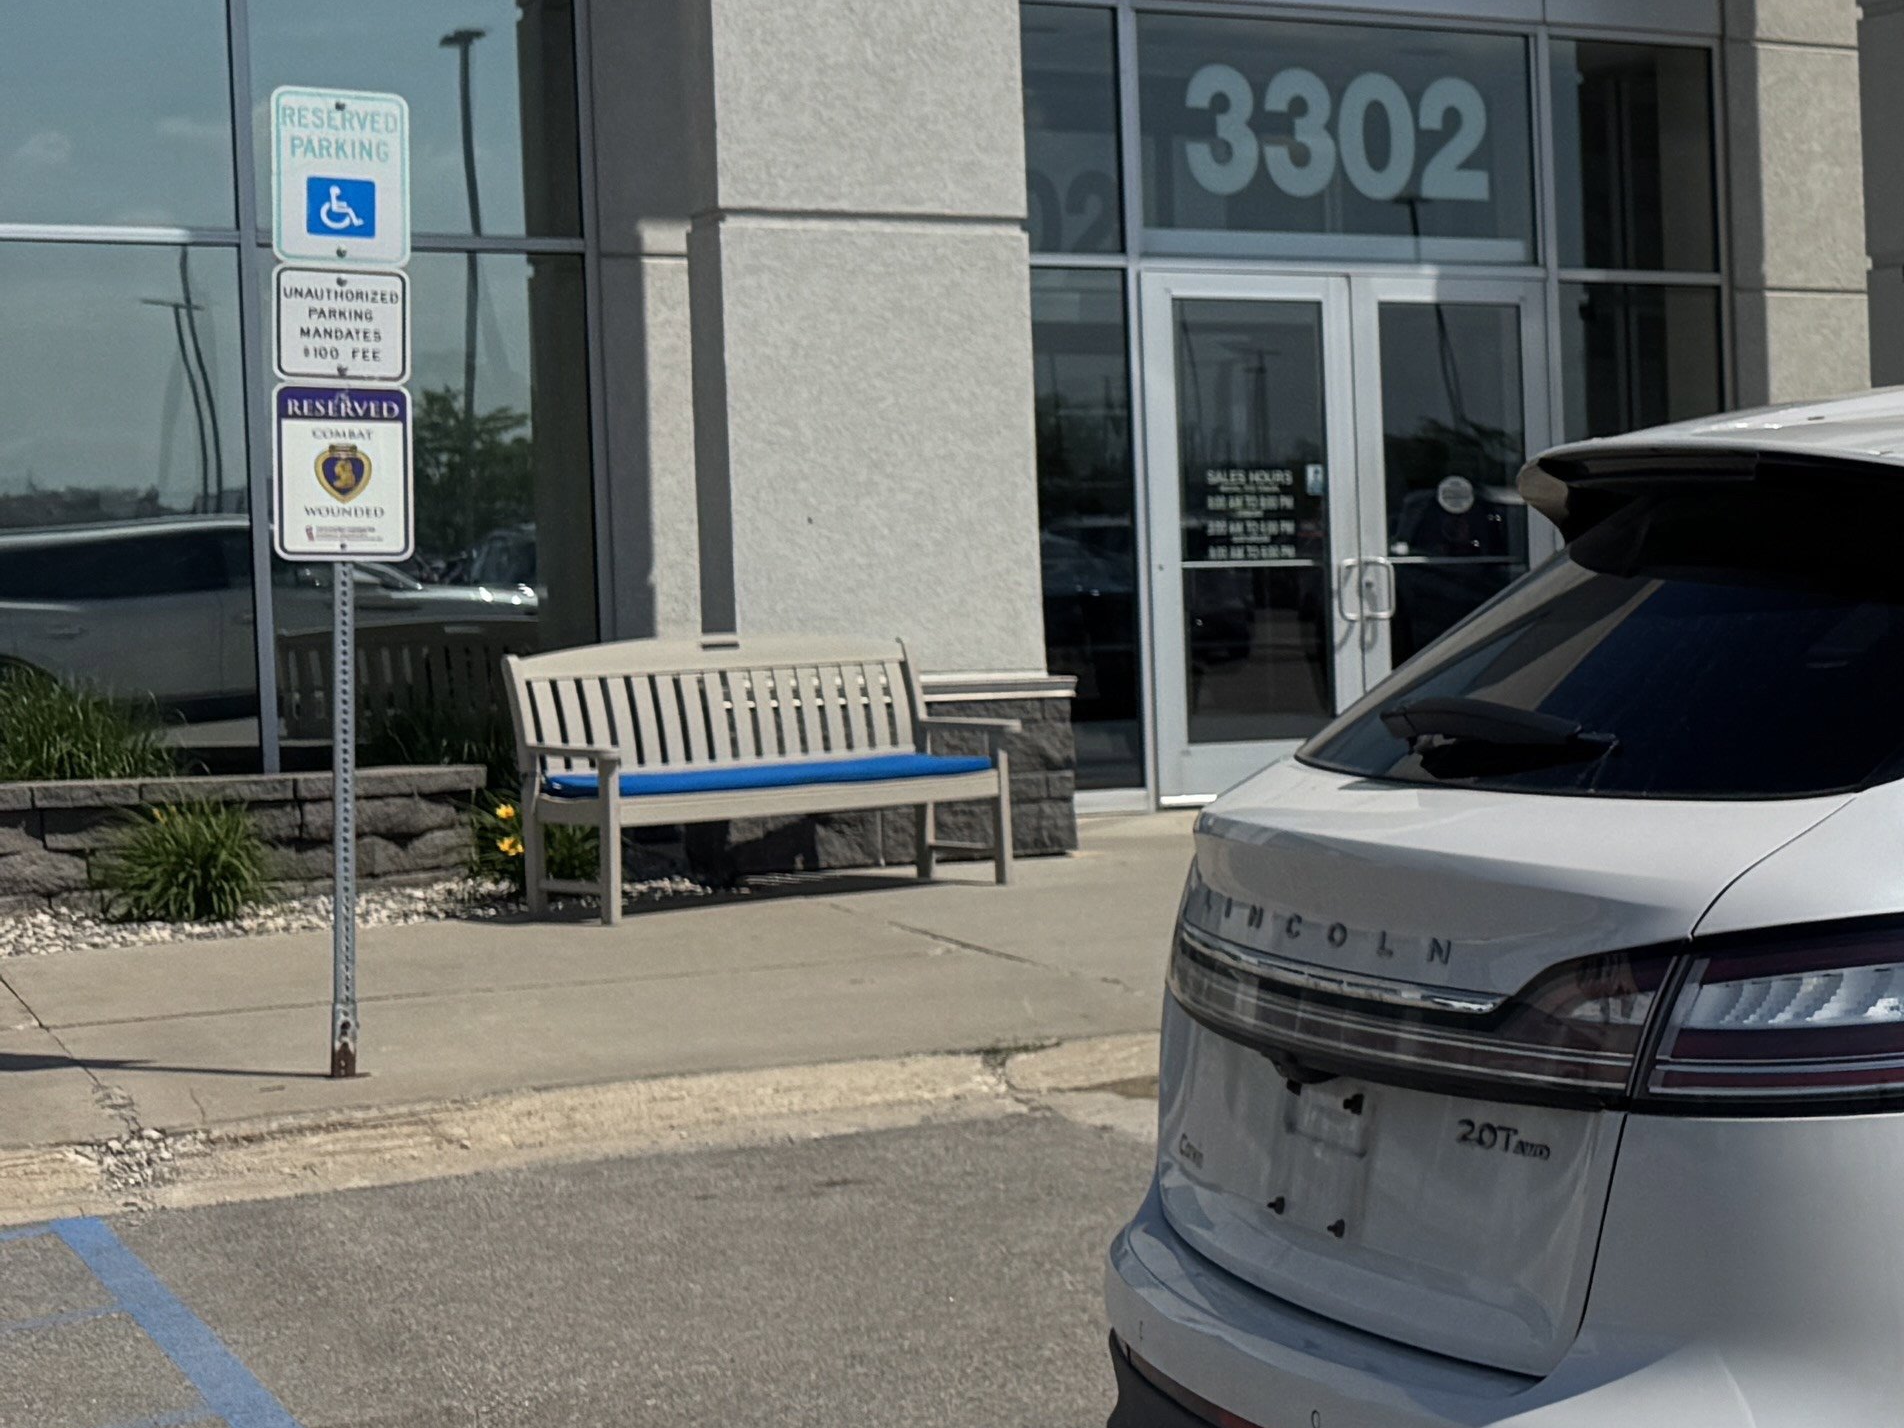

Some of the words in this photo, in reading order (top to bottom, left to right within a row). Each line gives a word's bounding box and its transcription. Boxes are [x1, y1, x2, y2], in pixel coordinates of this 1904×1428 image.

[282, 106, 398, 134] RESERVED
[1185, 62, 1490, 201] 3302
[290, 136, 390, 163] PARKING
[283, 286, 399, 305] UNAUTHORIZED
[308, 307, 374, 322] PARKING
[300, 326, 382, 343] MANDATES
[351, 348, 381, 362] FEE
[287, 398, 400, 419] RESERVED
[312, 428, 373, 441] COMBAT
[304, 504, 385, 519] WOUNDED
[1204, 889, 1451, 965] LINCOLN
